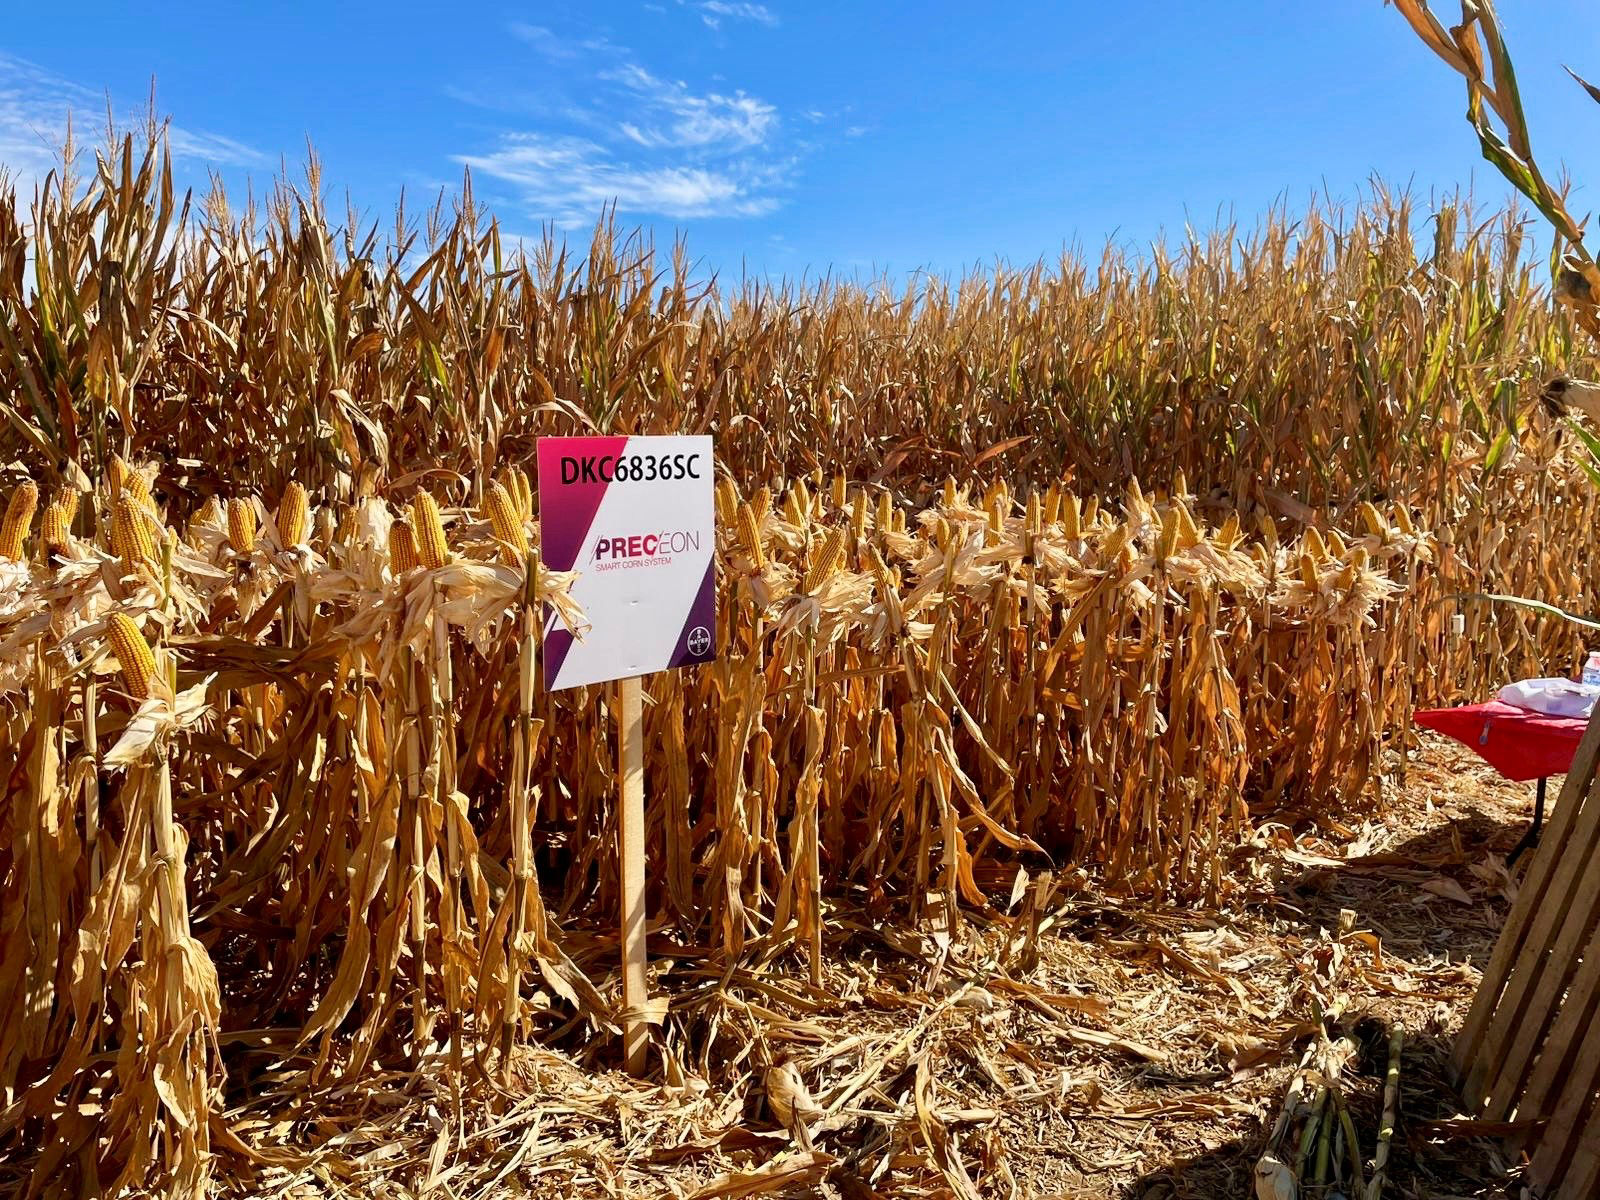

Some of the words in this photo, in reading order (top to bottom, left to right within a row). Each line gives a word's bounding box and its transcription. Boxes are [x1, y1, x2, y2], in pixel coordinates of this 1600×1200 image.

[561, 454, 700, 484] DKC6836SC
[595, 530, 700, 560] PRECEON
[595, 561, 621, 572] SMART
[622, 559, 643, 569] CORN
[644, 557, 672, 567] SYSTEM
